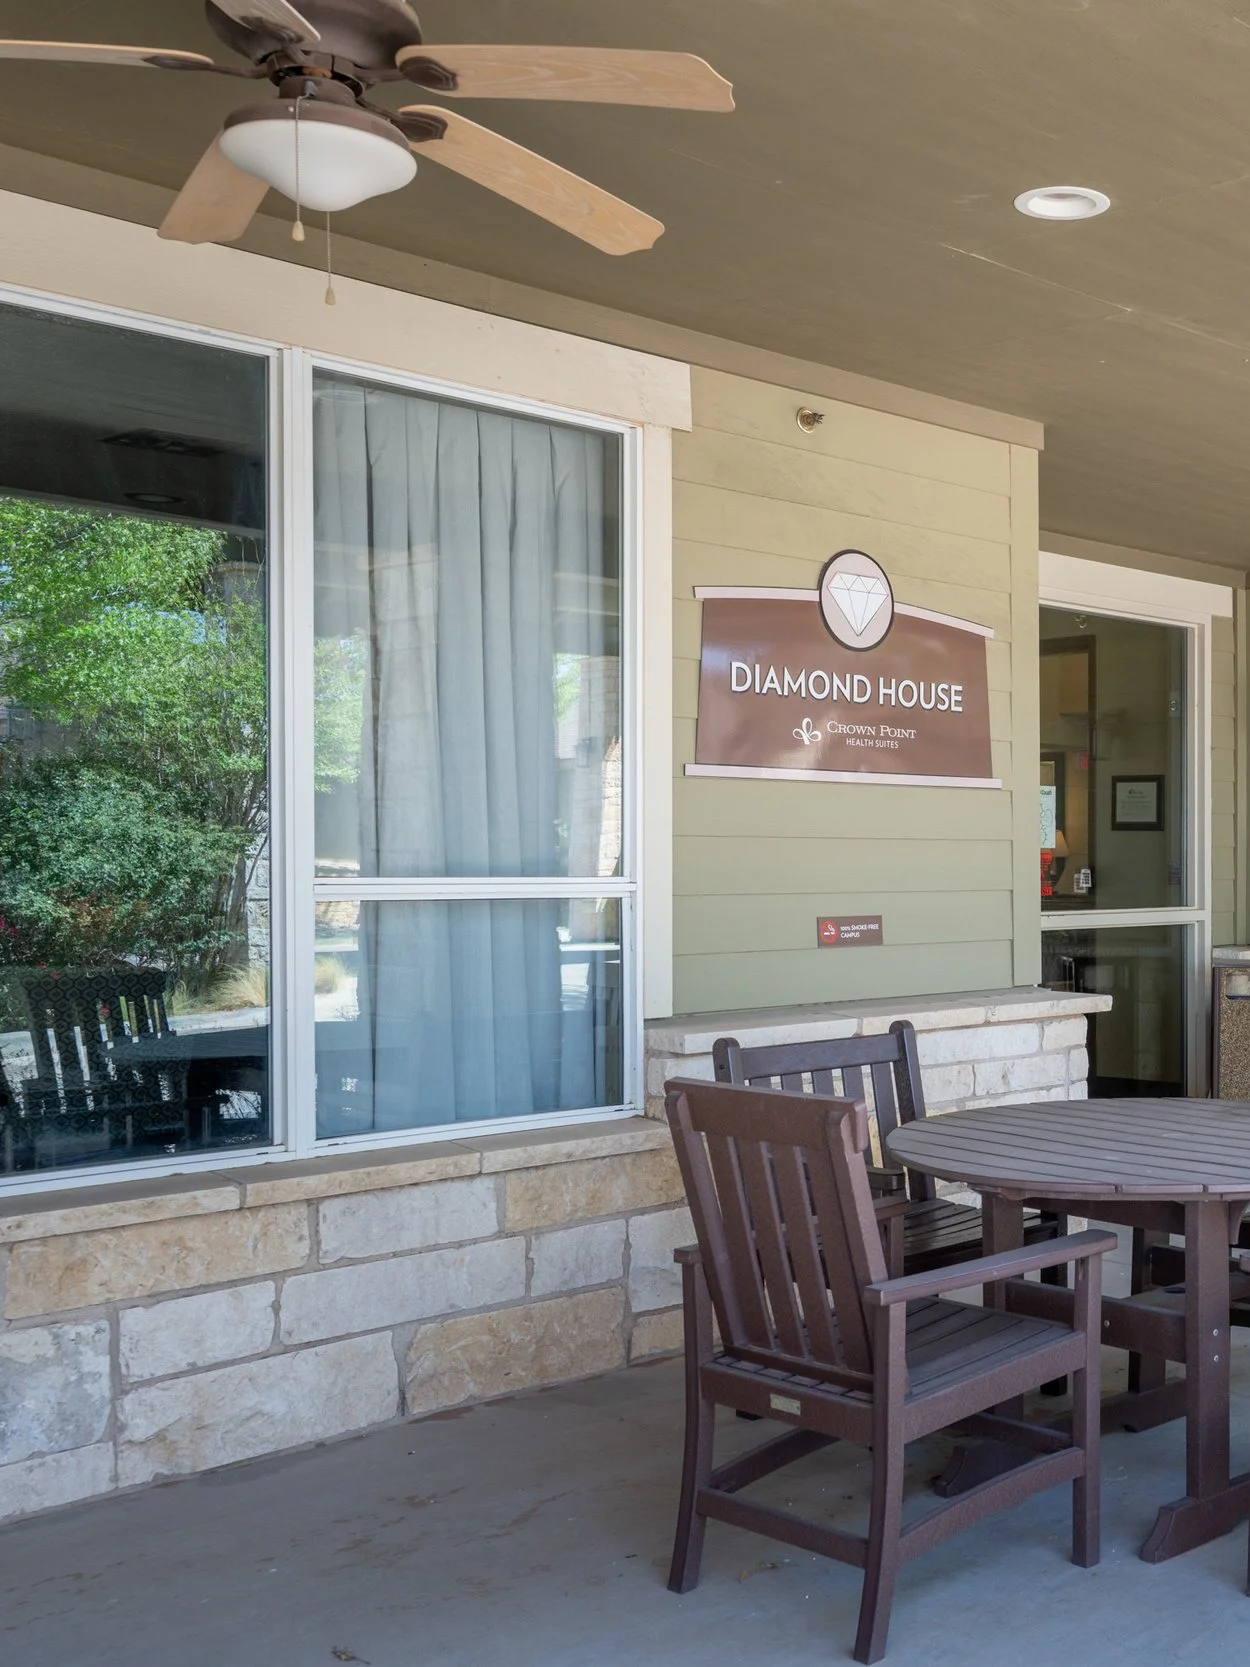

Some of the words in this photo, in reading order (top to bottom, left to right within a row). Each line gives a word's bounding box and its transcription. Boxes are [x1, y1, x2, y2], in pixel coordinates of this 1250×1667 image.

[730, 661, 872, 703] DIAMOND
[878, 677, 963, 712] HOUSE
[827, 720, 876, 736] CROWN
[879, 725, 917, 739] POINT
[846, 737, 874, 747] HEALTH
[875, 739, 899, 749] SUITES
